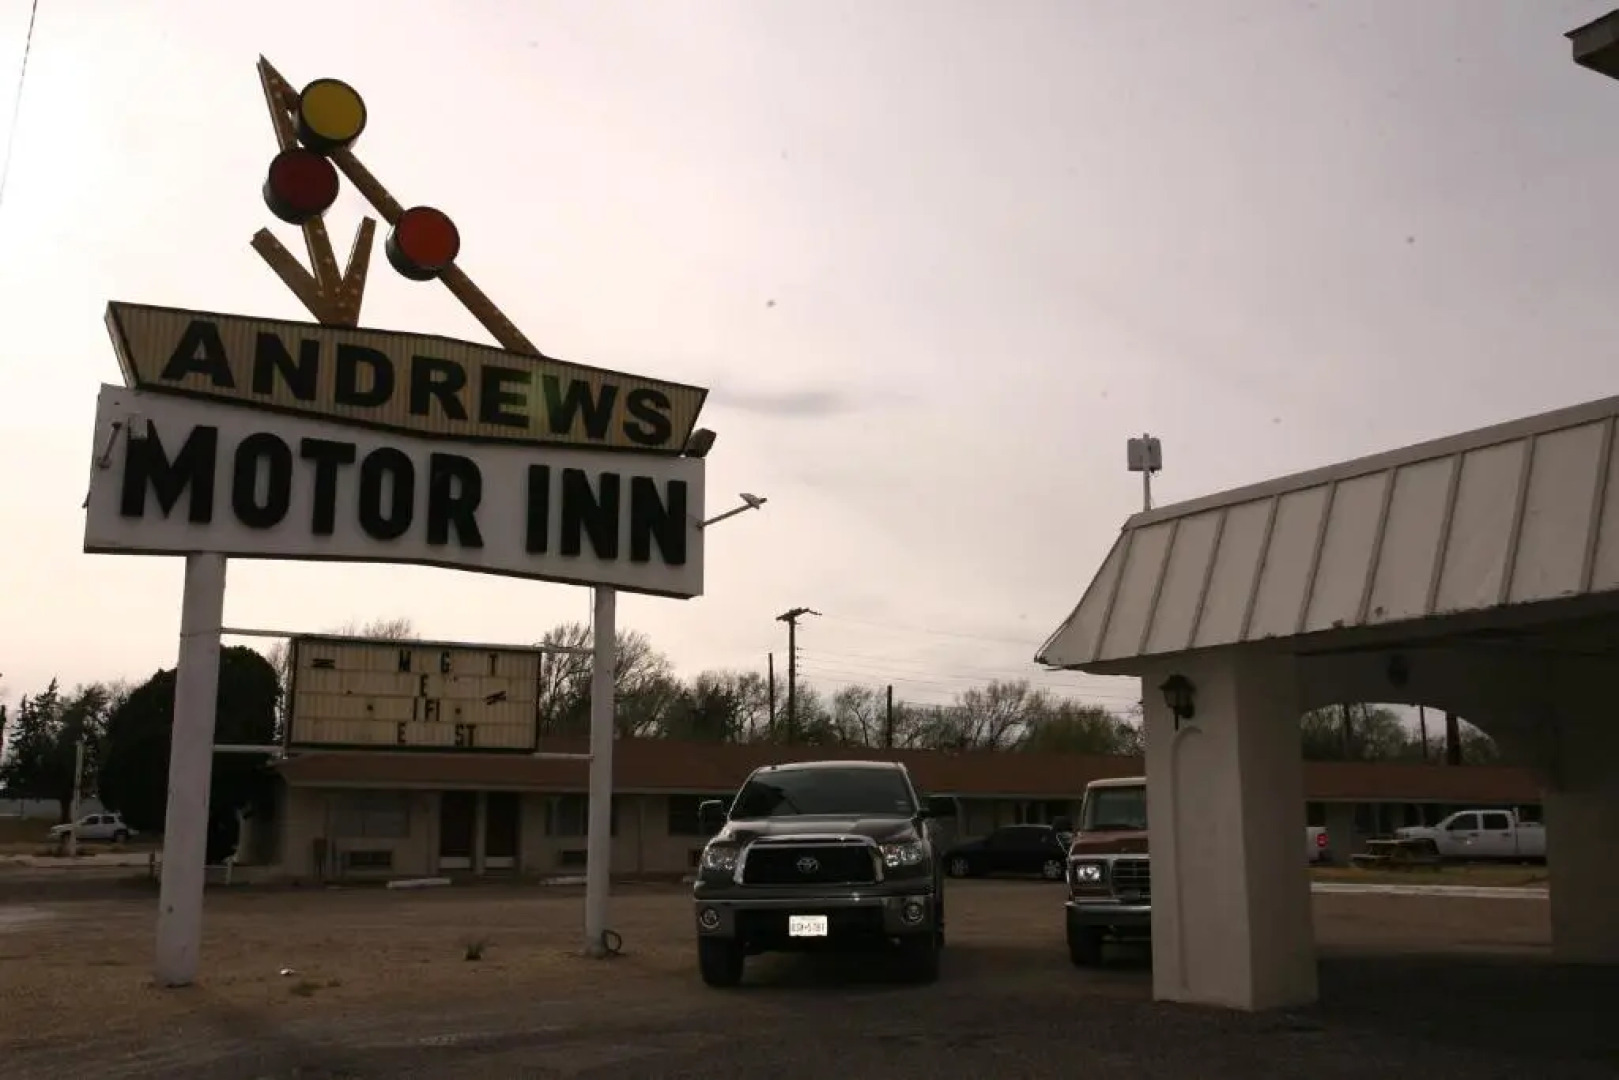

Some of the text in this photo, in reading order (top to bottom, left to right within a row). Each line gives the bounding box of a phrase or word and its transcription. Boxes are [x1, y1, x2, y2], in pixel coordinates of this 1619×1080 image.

[160, 319, 673, 446] ANDREWS
[119, 417, 688, 566] MOTOR INN
[489, 653, 499, 677] T
